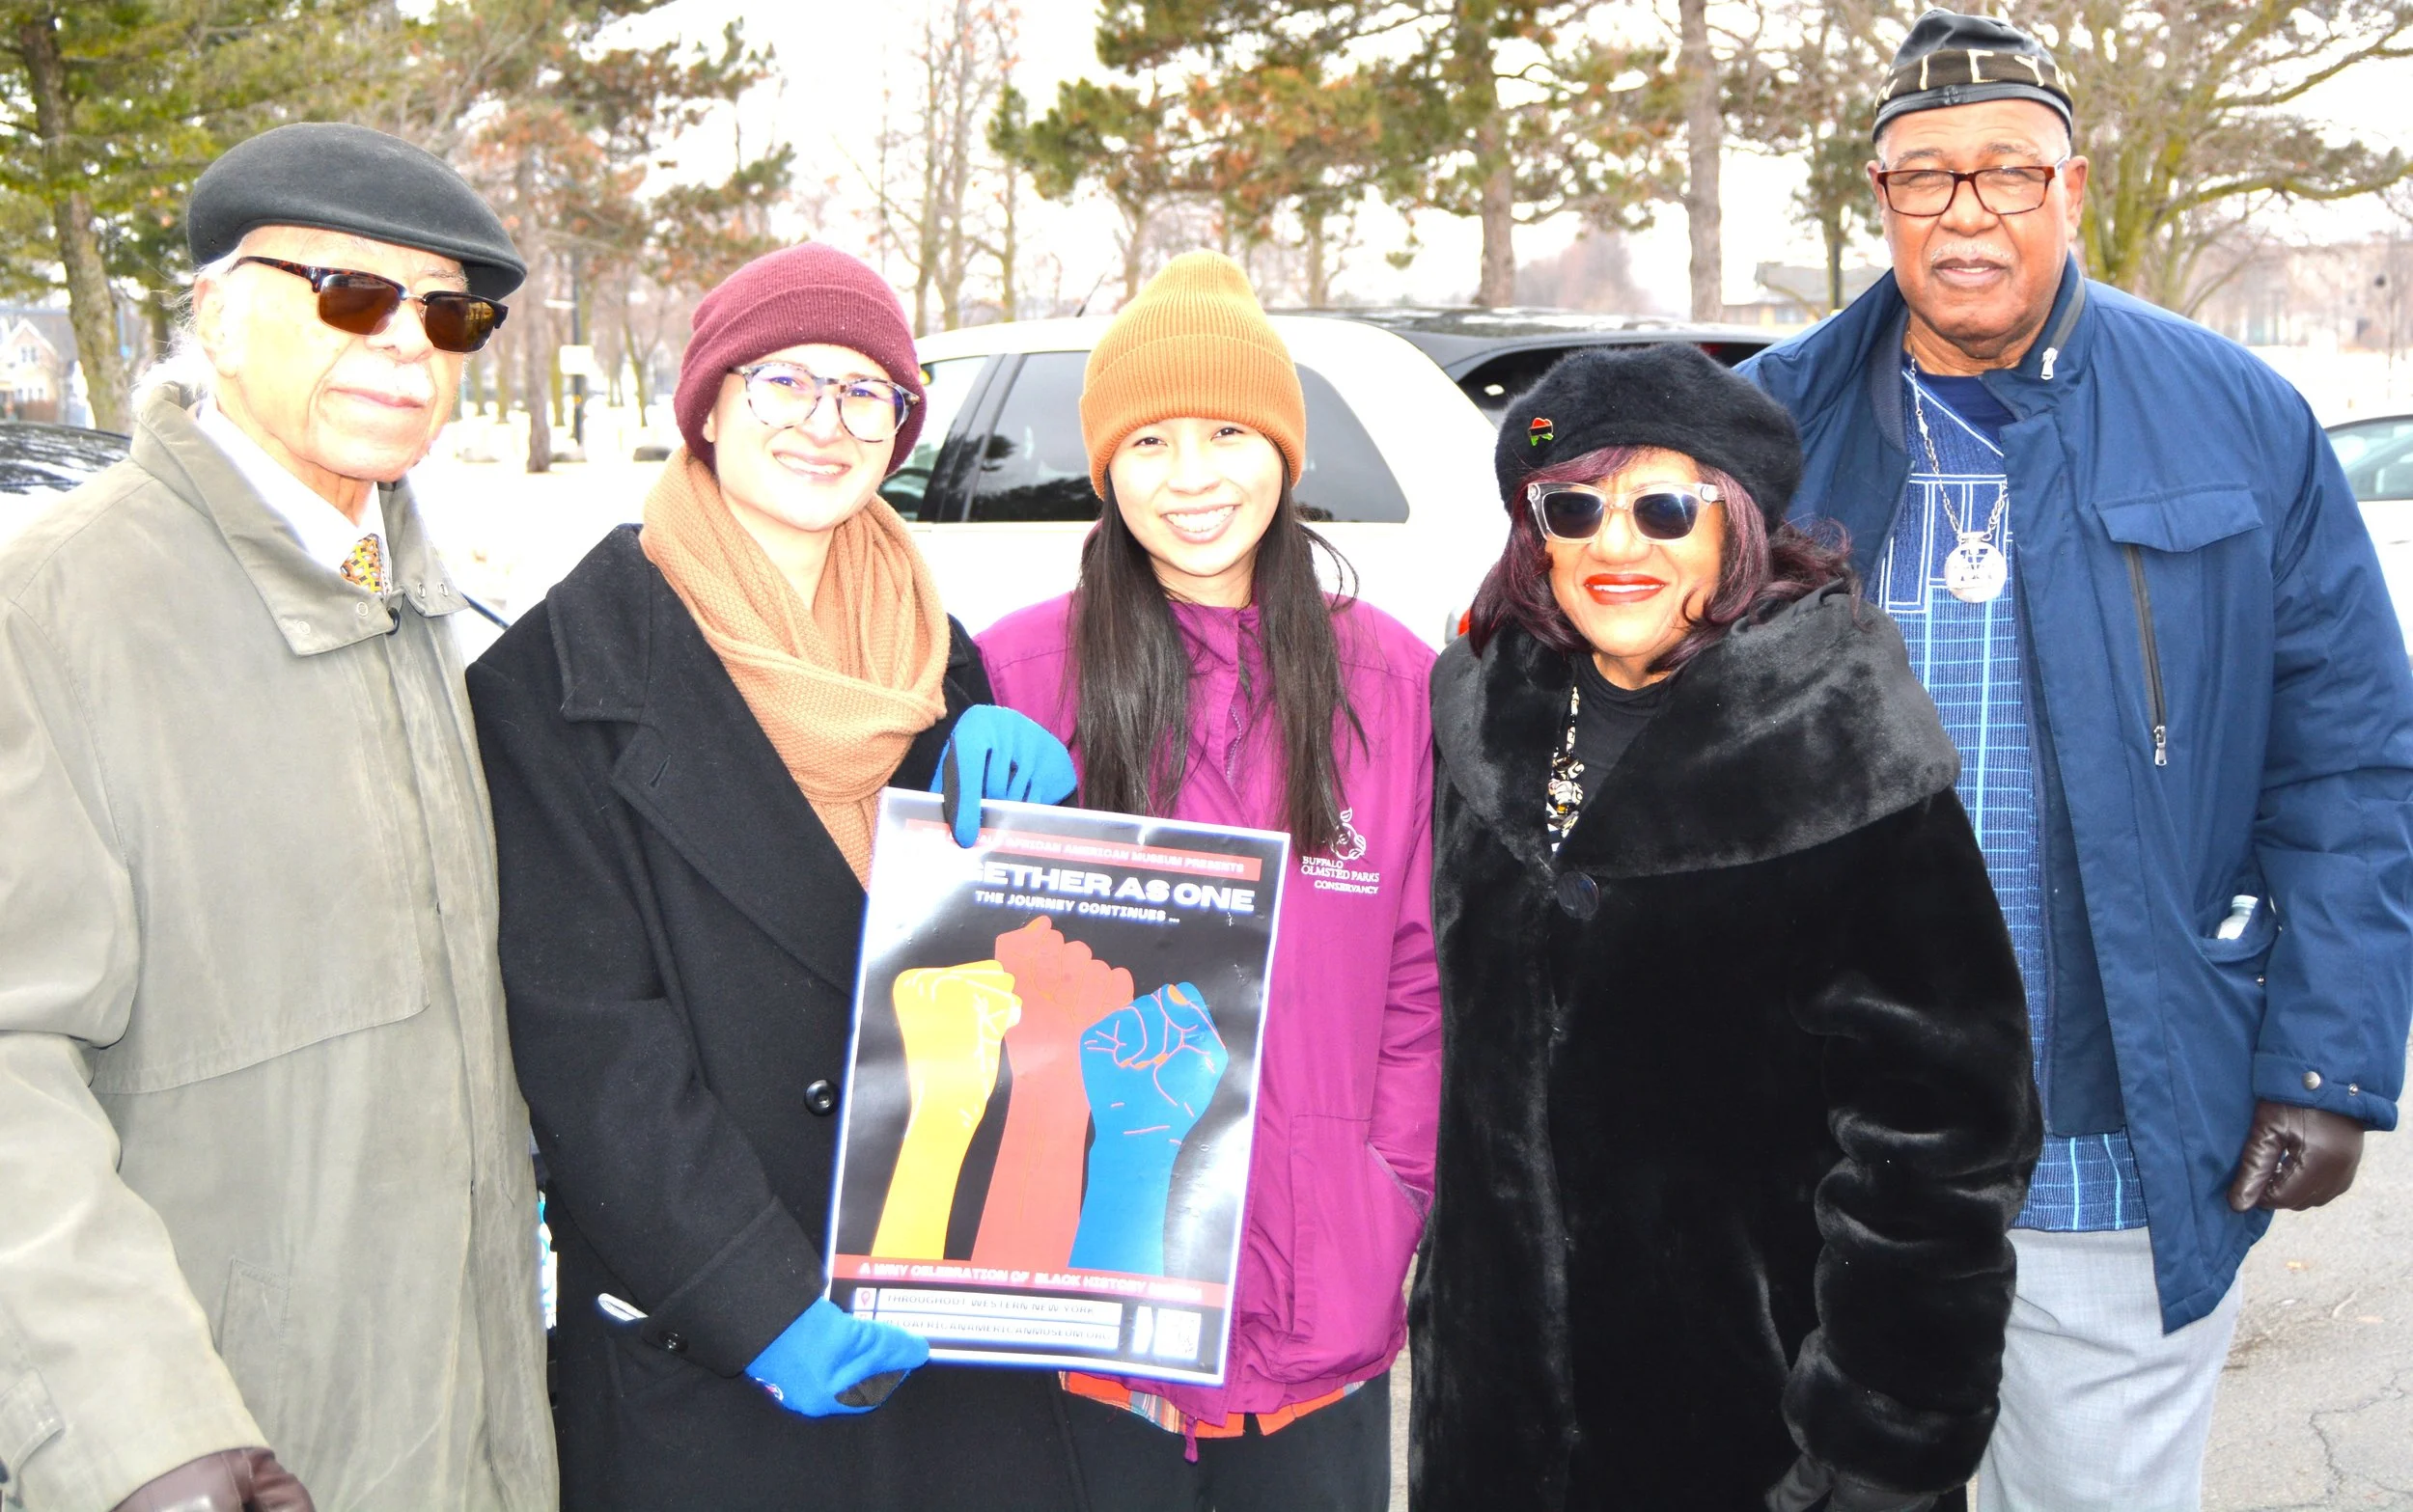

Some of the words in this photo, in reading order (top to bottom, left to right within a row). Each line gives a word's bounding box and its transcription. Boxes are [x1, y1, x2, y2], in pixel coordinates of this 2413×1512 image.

[1066, 843, 1129, 861] AMERICAN
[1131, 852, 1182, 866] MUSEUM
[1185, 857, 1244, 873] PRESENTS
[1302, 856, 1344, 869] BUFFALO
[979, 861, 1112, 895] ETHER
[1114, 876, 1170, 902] AS
[1174, 882, 1255, 912] ONE
[1301, 865, 1350, 880] OLMSTED
[1351, 870, 1380, 883] PARKS
[1314, 880, 1379, 894] CONSERVANCY
[975, 890, 1005, 904] THE
[1009, 893, 1075, 912] JOURNEY
[1078, 901, 1166, 922] CONTINUES
[859, 1262, 871, 1275] A
[874, 1263, 908, 1278] WNY
[911, 1265, 1008, 1281] CELEBRATION
[1011, 1270, 1030, 1283] OF
[1035, 1273, 1081, 1287] BLACK
[1084, 1276, 1147, 1294] HISTORY
[887, 1295, 965, 1306] THROUGHOUT
[971, 1299, 1028, 1311] WESTERN
[1032, 1303, 1060, 1313] NEW
[1063, 1304, 1095, 1315] YORK
